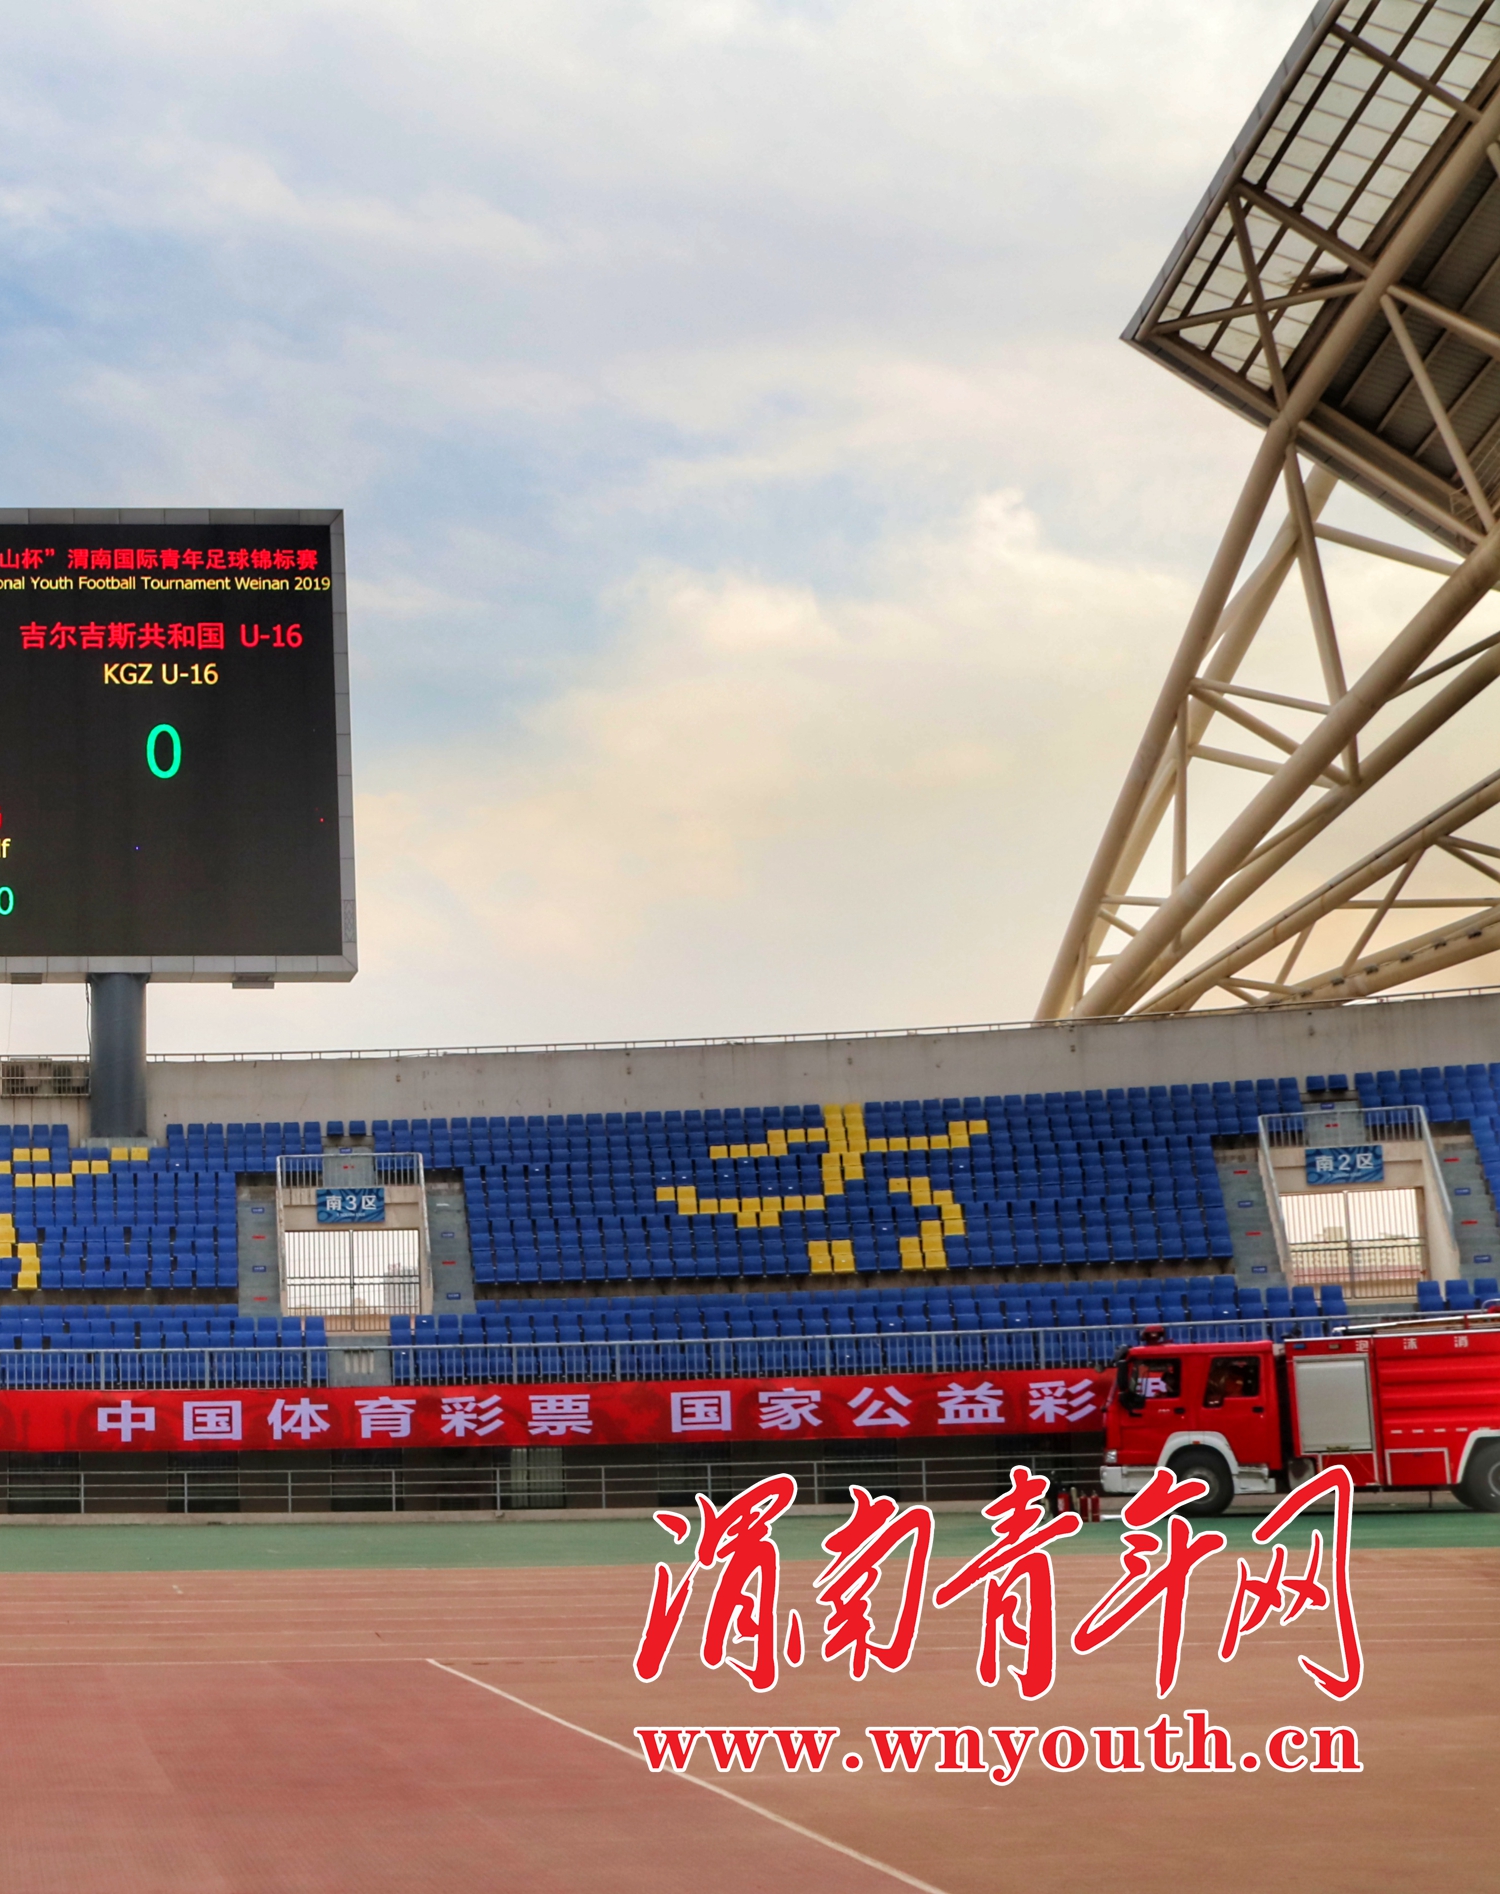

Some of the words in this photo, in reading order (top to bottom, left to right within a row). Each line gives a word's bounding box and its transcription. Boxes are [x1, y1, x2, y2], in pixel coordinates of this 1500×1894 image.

[30, 575, 74, 590] Youth
[78, 575, 136, 590] Football
[140, 575, 232, 591] Tournament
[234, 576, 290, 591] Weinan
[294, 576, 332, 591] 2019
[19, 621, 225, 651] 吉尔吉斯共和国
[239, 623, 304, 649] U-16
[103, 662, 154, 685] KGZ
[161, 662, 219, 685] U-16
[146, 724, 182, 778] 0
[1315, 1153, 1374, 1172] 南2区
[326, 1195, 377, 1211] 南3区
[96, 1394, 594, 1443] 中国体育彩票
